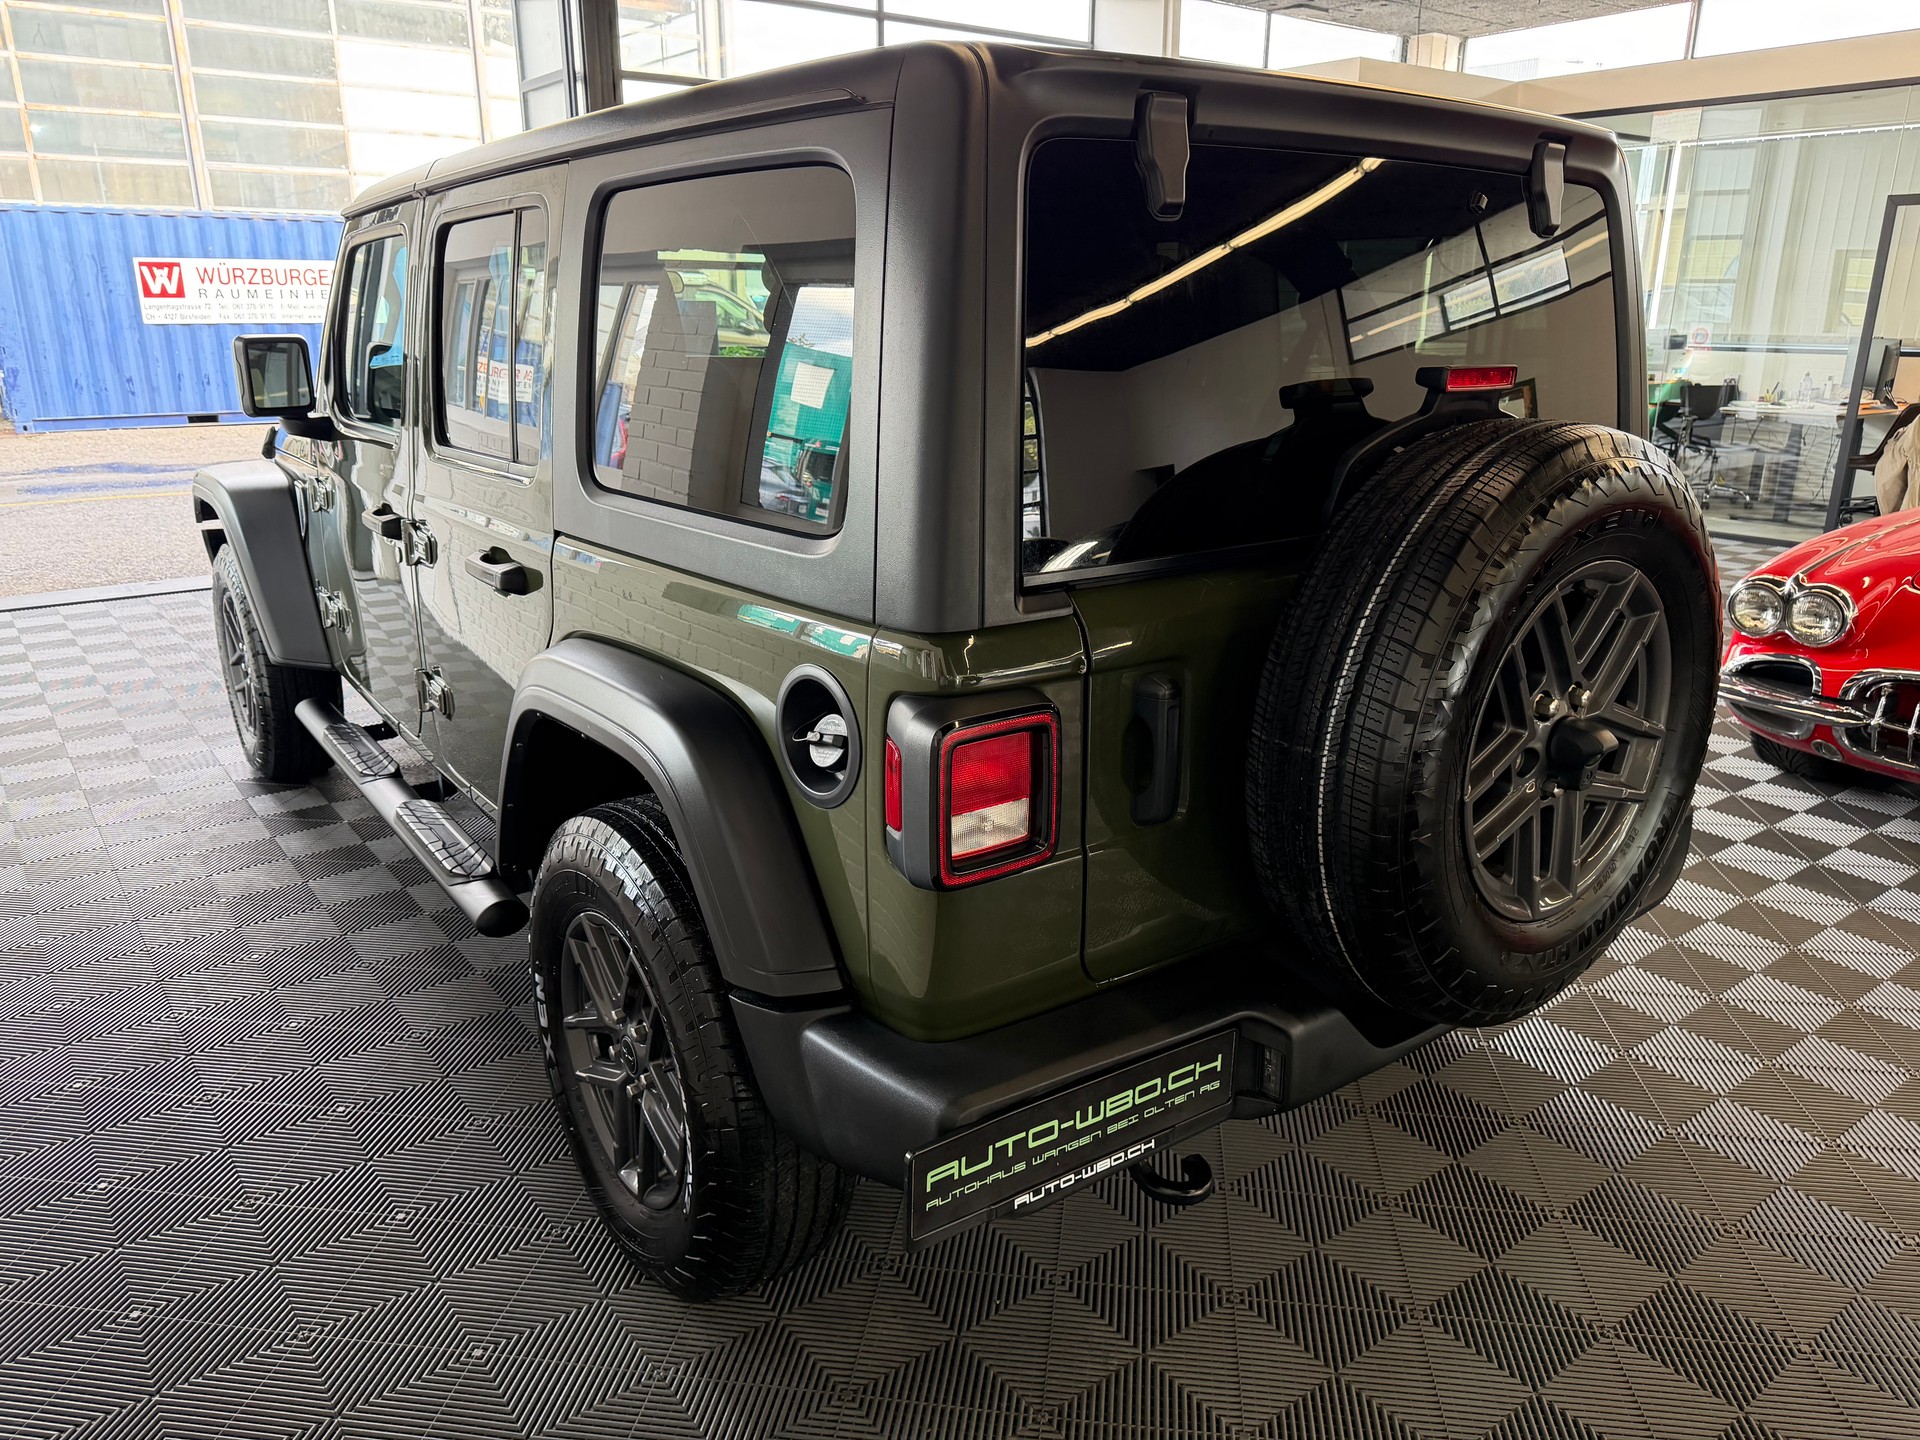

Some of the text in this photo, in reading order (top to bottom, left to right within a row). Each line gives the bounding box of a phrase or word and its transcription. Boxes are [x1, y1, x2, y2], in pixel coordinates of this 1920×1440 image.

[195, 262, 333, 286] WÜRZBURGE
[925, 1080, 1221, 1212] AUTOHAUS WANGEN BEI OLTEN AG
[926, 1054, 1222, 1193] AUTO-WBO.CH
[1014, 1138, 1155, 1210] AUTO-WBO.CH
